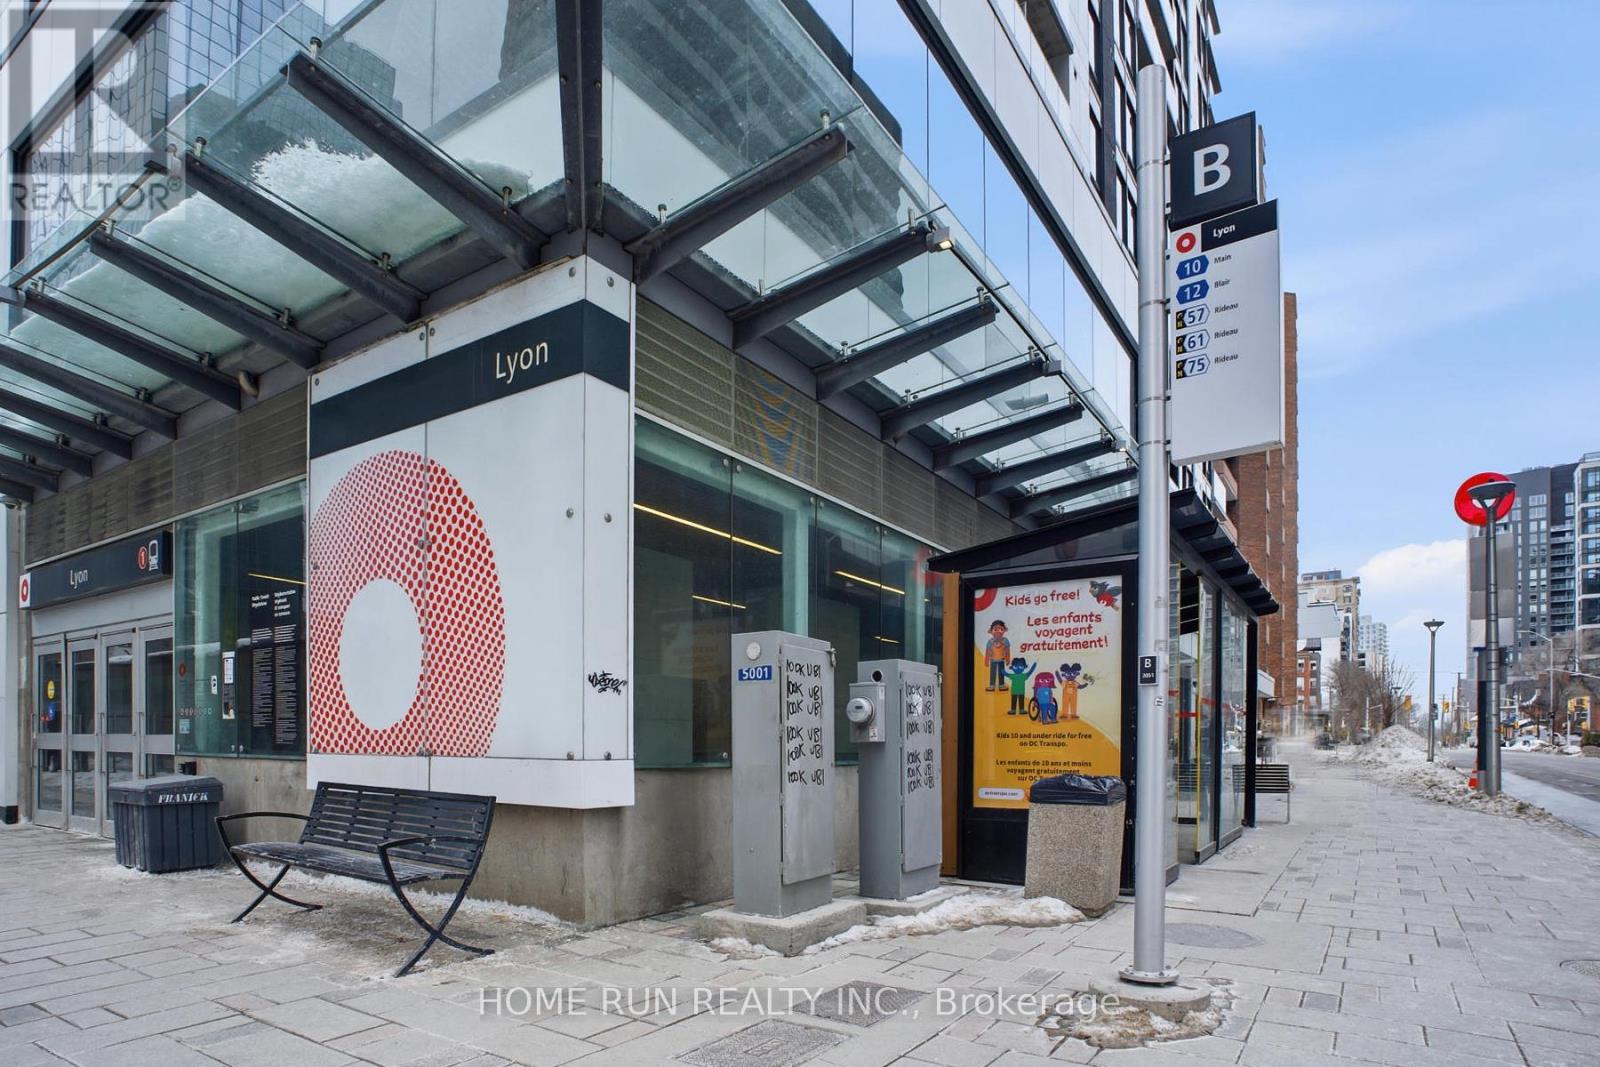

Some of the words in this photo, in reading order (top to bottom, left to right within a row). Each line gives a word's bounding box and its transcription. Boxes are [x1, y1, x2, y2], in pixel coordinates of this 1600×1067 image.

[1193, 143, 1232, 197] B
[1213, 225, 1236, 238] Lyon
[1184, 259, 1201, 275] 10
[1214, 254, 1232, 264] Main
[1184, 284, 1201, 300] 12
[1214, 279, 1231, 288] Blair
[1187, 308, 1205, 324] 57
[1214, 303, 1239, 314] Rideau
[1187, 333, 1204, 349] 61
[1214, 328, 1239, 339] Rideau
[496, 342, 549, 384] Lyon
[1187, 357, 1205, 374] 75
[1214, 354, 1239, 364] Rideau
[70, 569, 88, 589] Lyon
[1005, 594, 1031, 606] Kids
[1034, 595, 1048, 605] go
[1050, 589, 1080, 601] free!
[1027, 616, 1049, 626] Les
[1051, 612, 1102, 624] enfants
[1035, 624, 1093, 639] voyagent
[1020, 636, 1109, 653] gratuitement!
[1144, 658, 1151, 668] B
[742, 667, 769, 680] 5001
[1039, 740, 1068, 748] Transpo.
